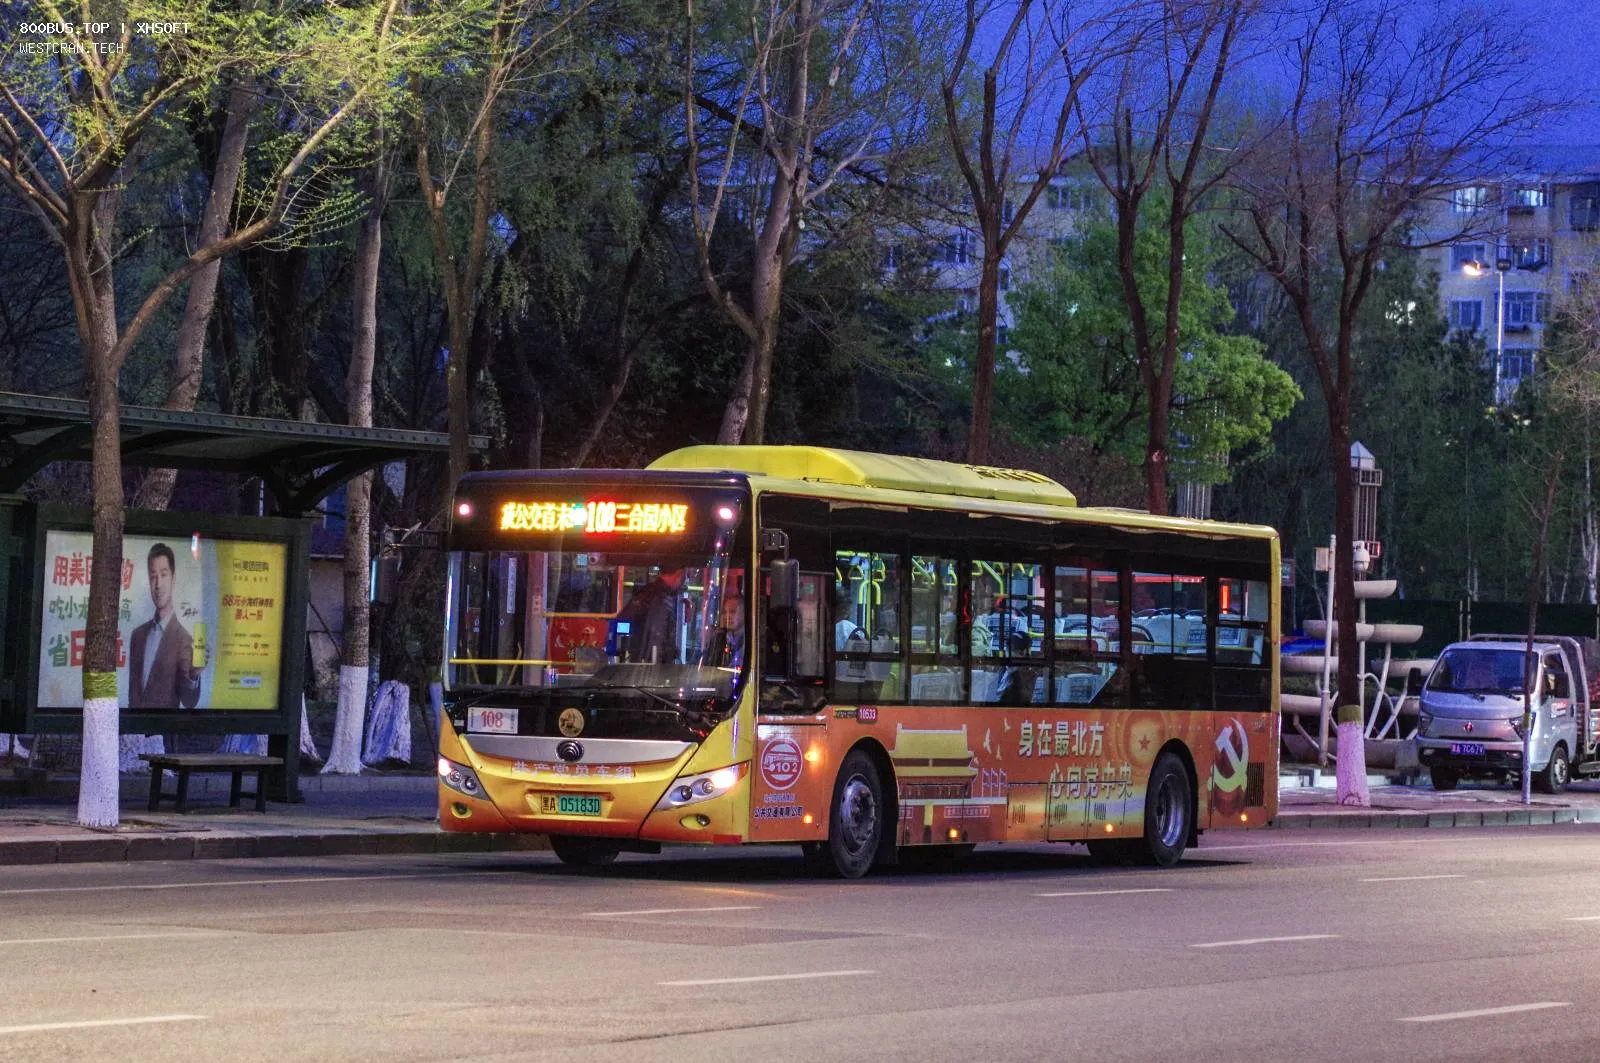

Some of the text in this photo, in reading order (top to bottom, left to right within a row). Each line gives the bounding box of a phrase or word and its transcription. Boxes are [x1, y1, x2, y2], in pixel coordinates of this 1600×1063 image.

[585, 501, 616, 533] 108
[480, 710, 504, 728] 108
[1018, 719, 1105, 757] 身在最北方
[1050, 762, 1133, 799] 心向党中央
